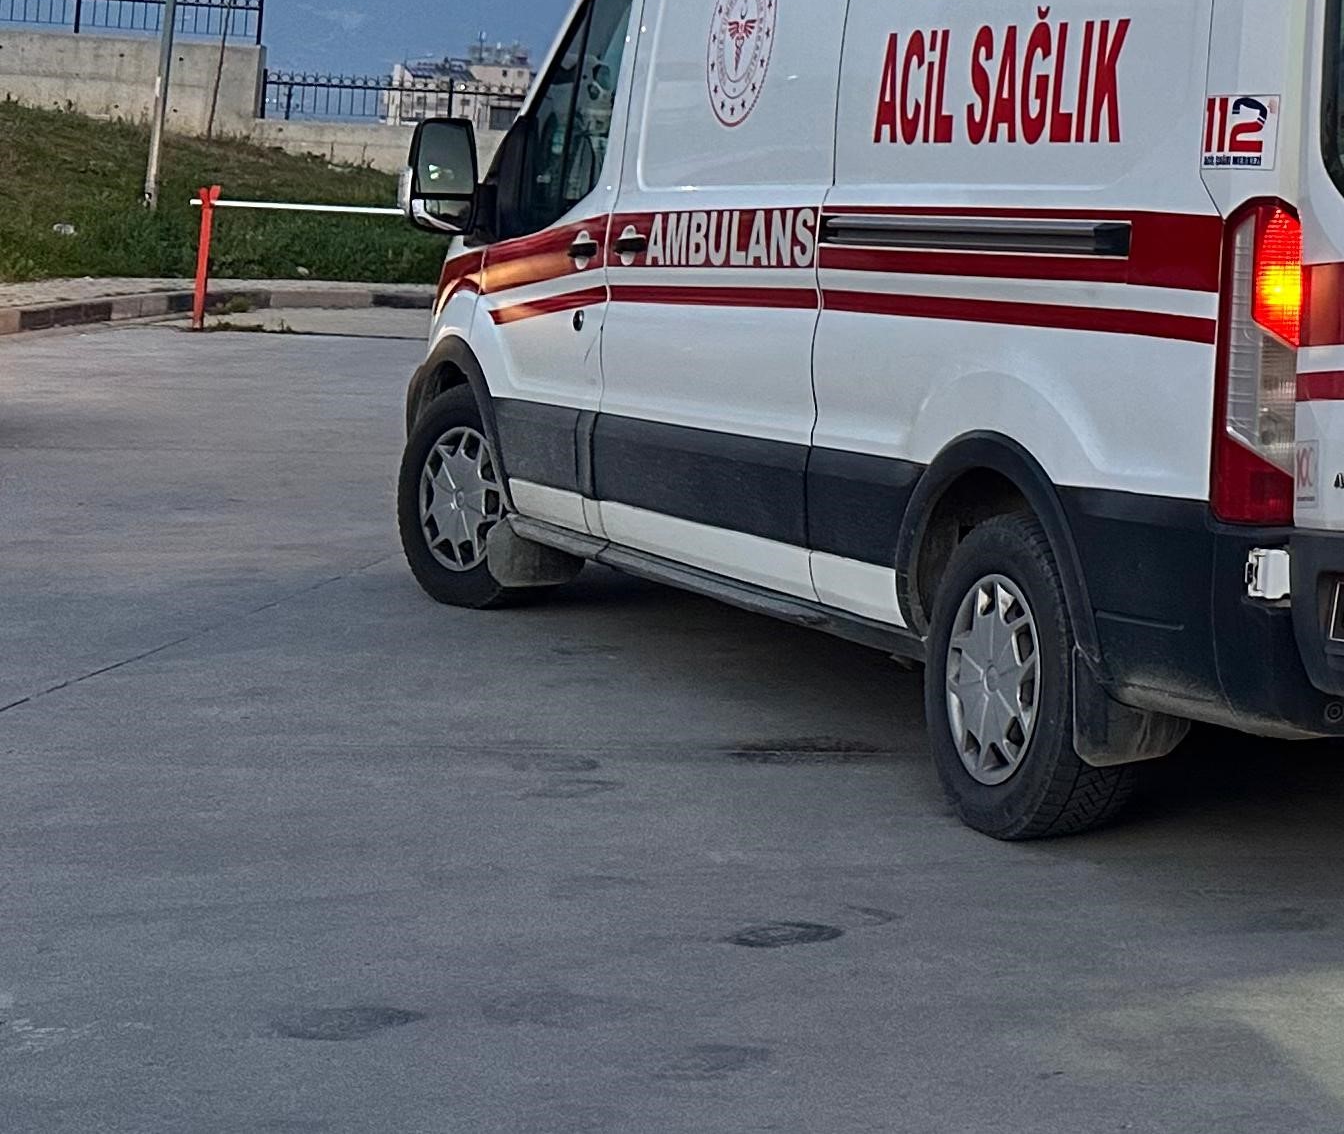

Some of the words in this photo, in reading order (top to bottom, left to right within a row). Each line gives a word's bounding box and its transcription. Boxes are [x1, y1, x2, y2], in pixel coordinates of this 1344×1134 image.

[873, 29, 953, 145] ACİL
[967, 5, 1131, 145] SAĞLIK
[1204, 97, 1268, 153] 112
[645, 208, 815, 267] AMBULANS
